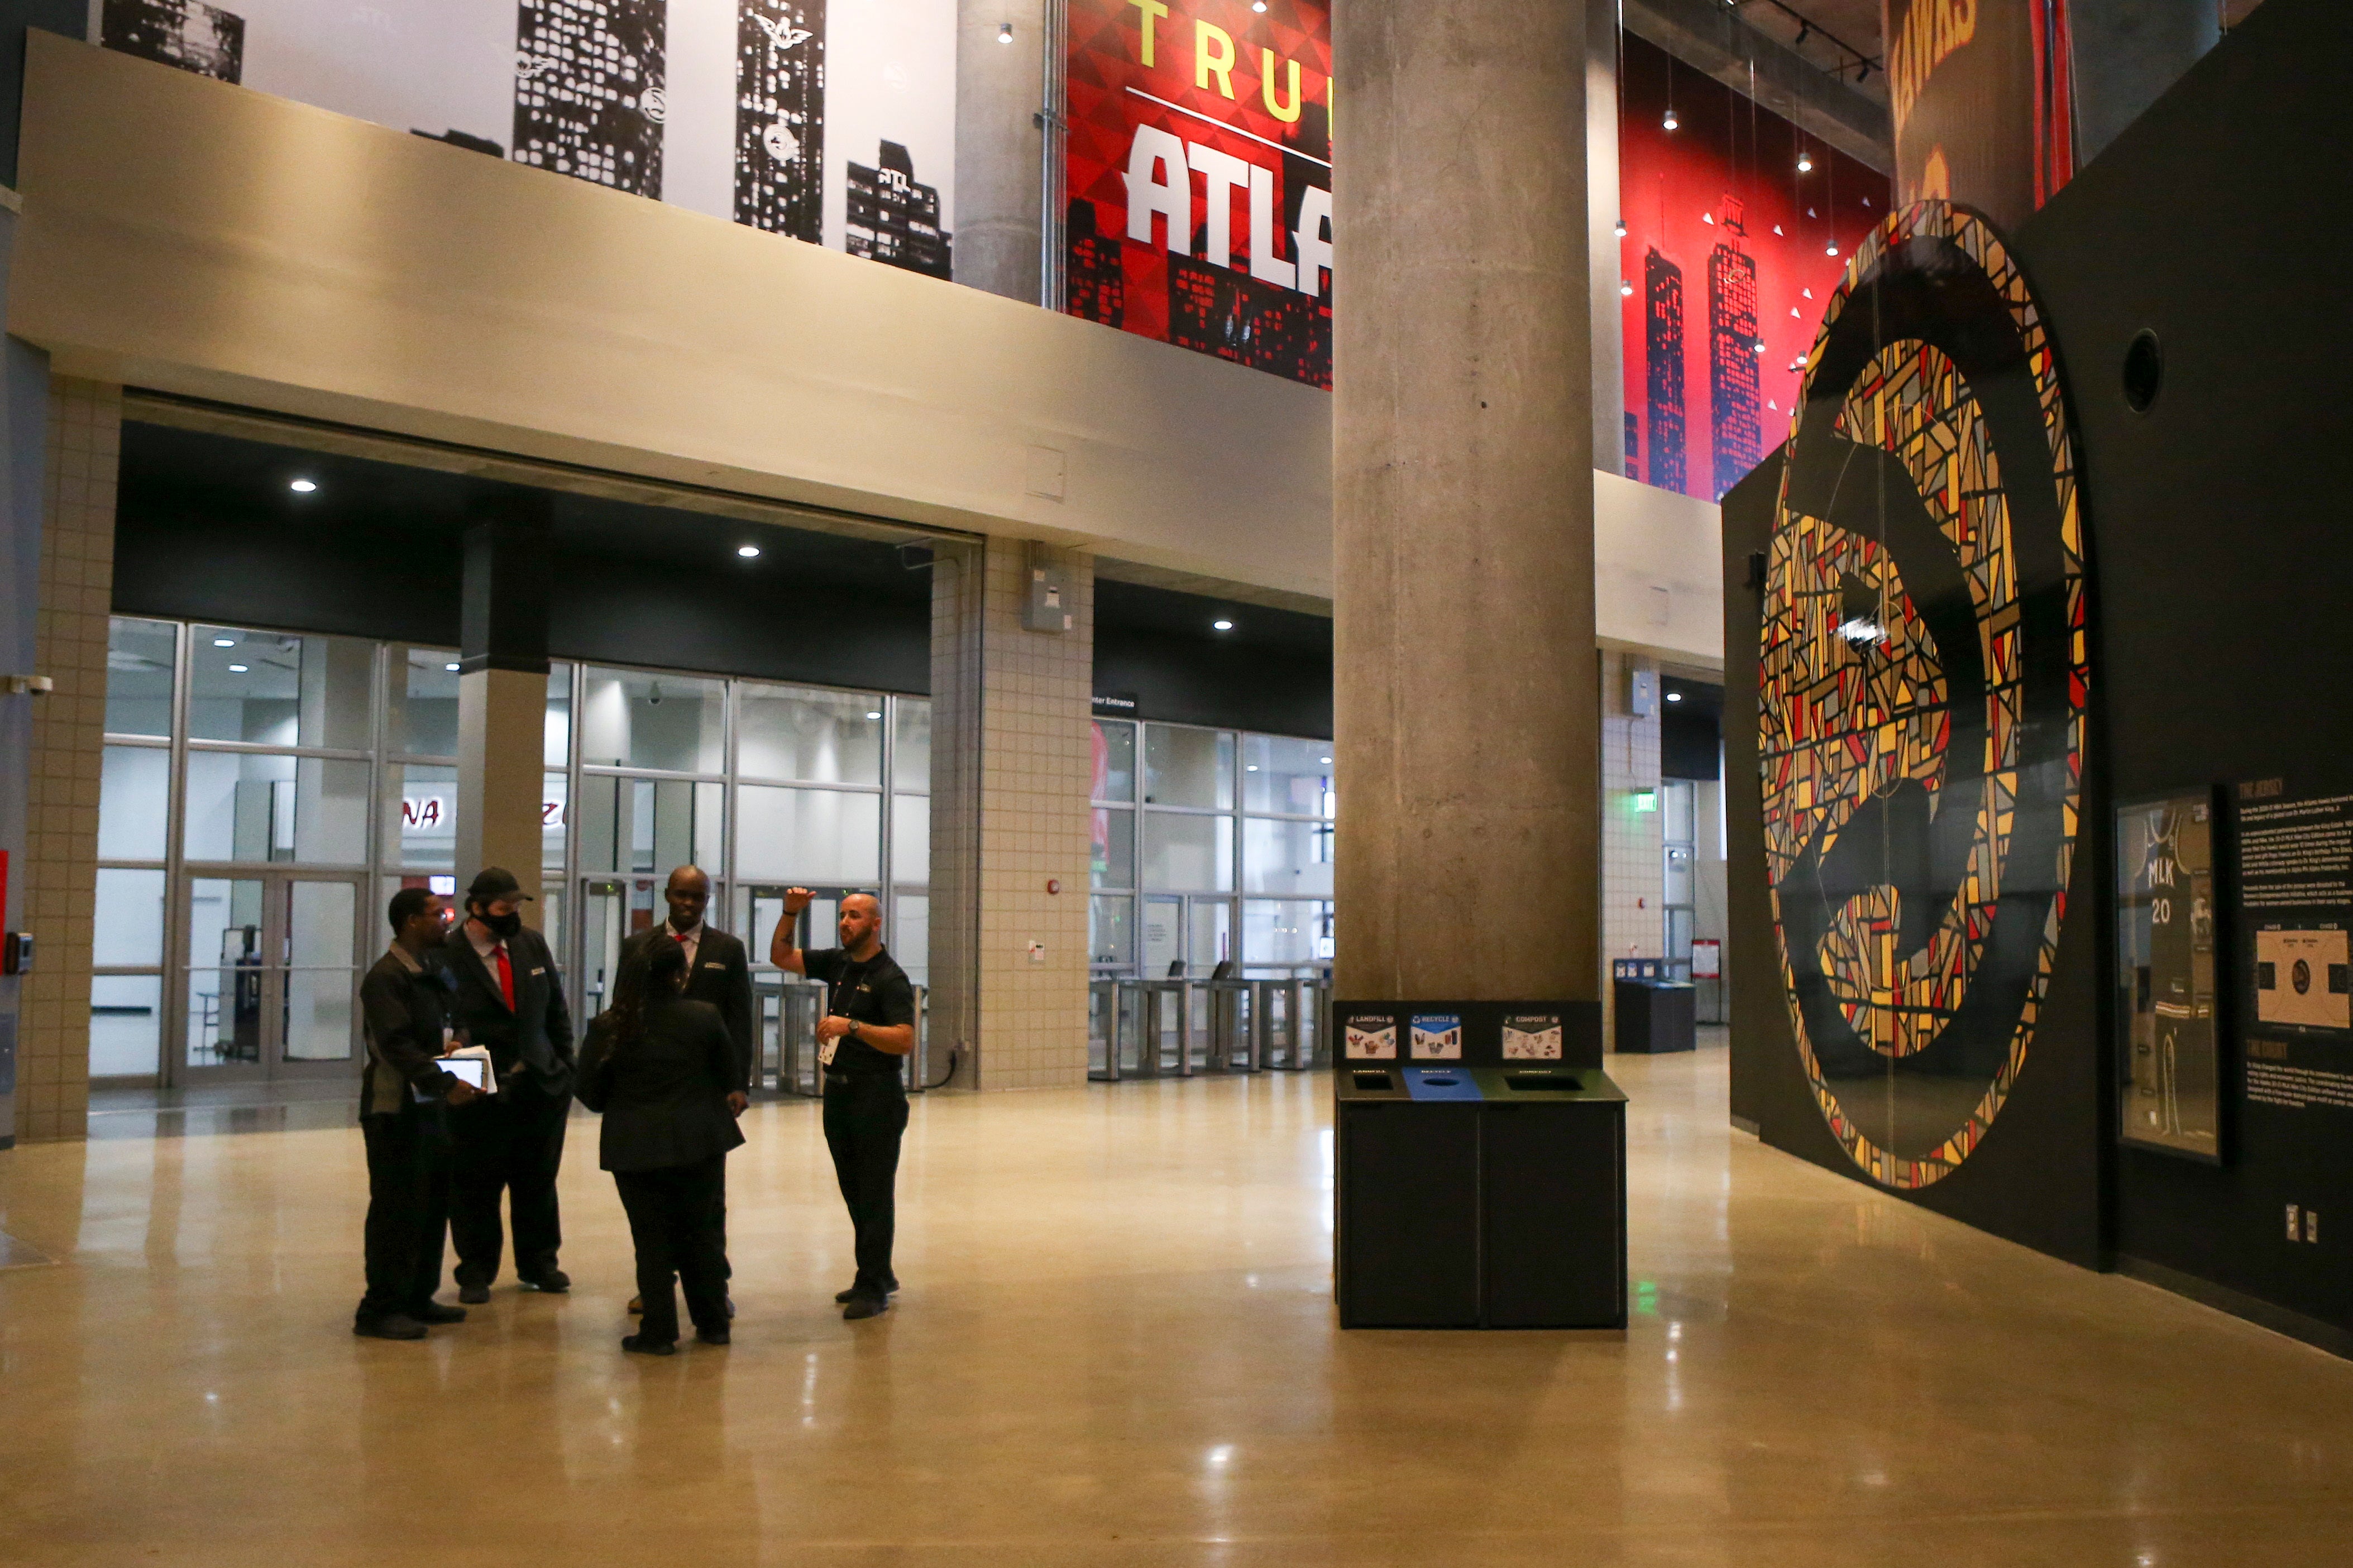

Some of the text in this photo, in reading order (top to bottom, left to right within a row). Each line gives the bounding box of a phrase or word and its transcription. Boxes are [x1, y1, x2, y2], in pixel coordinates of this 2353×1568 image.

[1128, 0, 1333, 141] TRU
[1107, 697, 1134, 707] Entrance
[2149, 857, 2175, 889] MLK
[2152, 899, 2170, 923] 20
